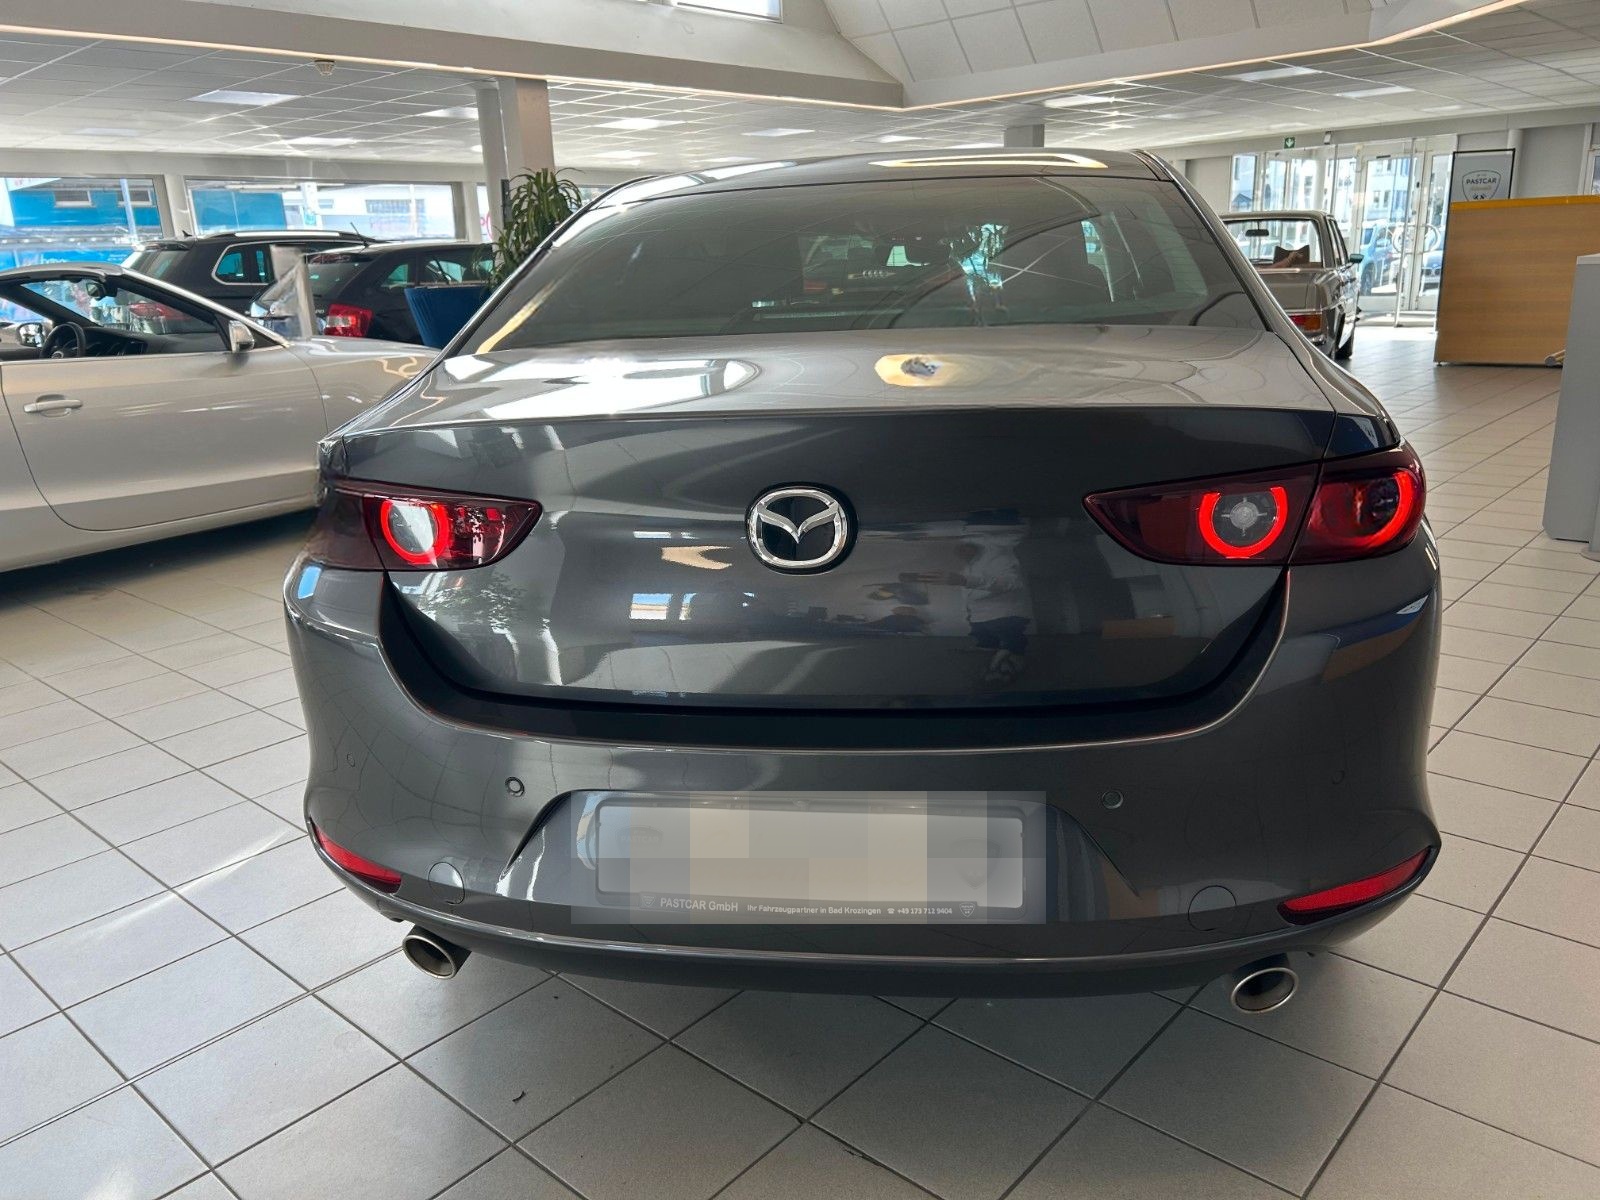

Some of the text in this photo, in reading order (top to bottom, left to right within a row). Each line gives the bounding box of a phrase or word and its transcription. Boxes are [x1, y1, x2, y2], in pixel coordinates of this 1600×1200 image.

[1466, 177, 1497, 185] PASTCAR
[660, 897, 706, 910] PASTCAR
[708, 900, 739, 912] GmbH
[747, 904, 758, 912] Ihr
[759, 904, 819, 915] Fahrzeugpartner
[820, 906, 827, 914] in
[844, 907, 882, 916] Krozingen
[897, 907, 910, 915] +49
[910, 907, 922, 915] 173
[923, 907, 936, 915] 712
[937, 907, 953, 915] 9404
